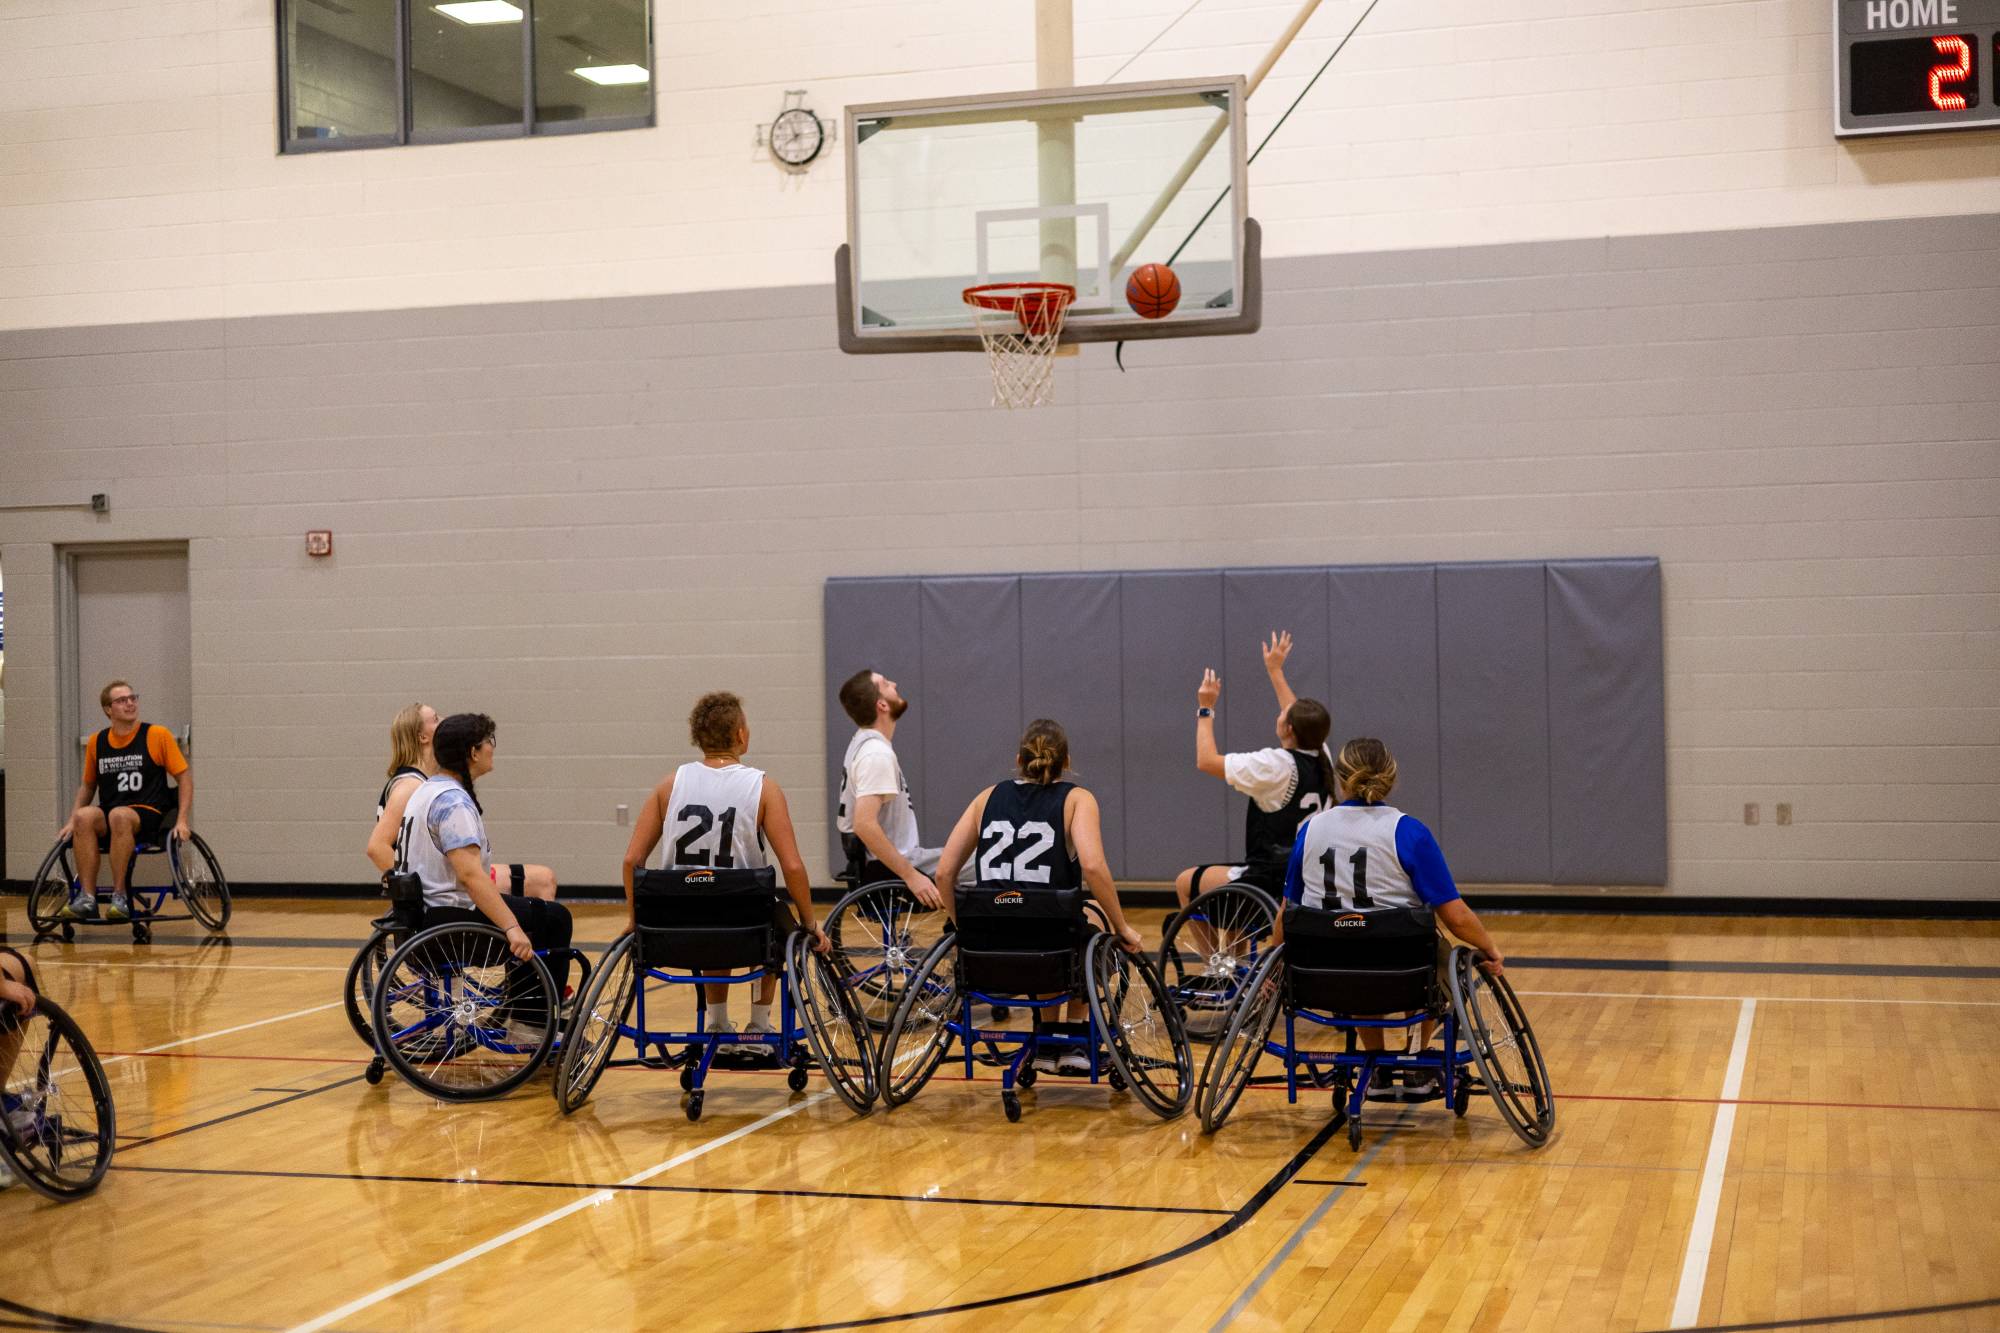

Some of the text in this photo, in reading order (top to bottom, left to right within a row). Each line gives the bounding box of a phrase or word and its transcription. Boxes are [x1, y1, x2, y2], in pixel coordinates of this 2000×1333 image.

[1867, 0, 1959, 30] HOME
[1928, 35, 1971, 111] 2
[117, 771, 143, 792] 20
[675, 804, 736, 868] 21
[980, 820, 1055, 884] 22
[1319, 847, 1375, 909] 11
